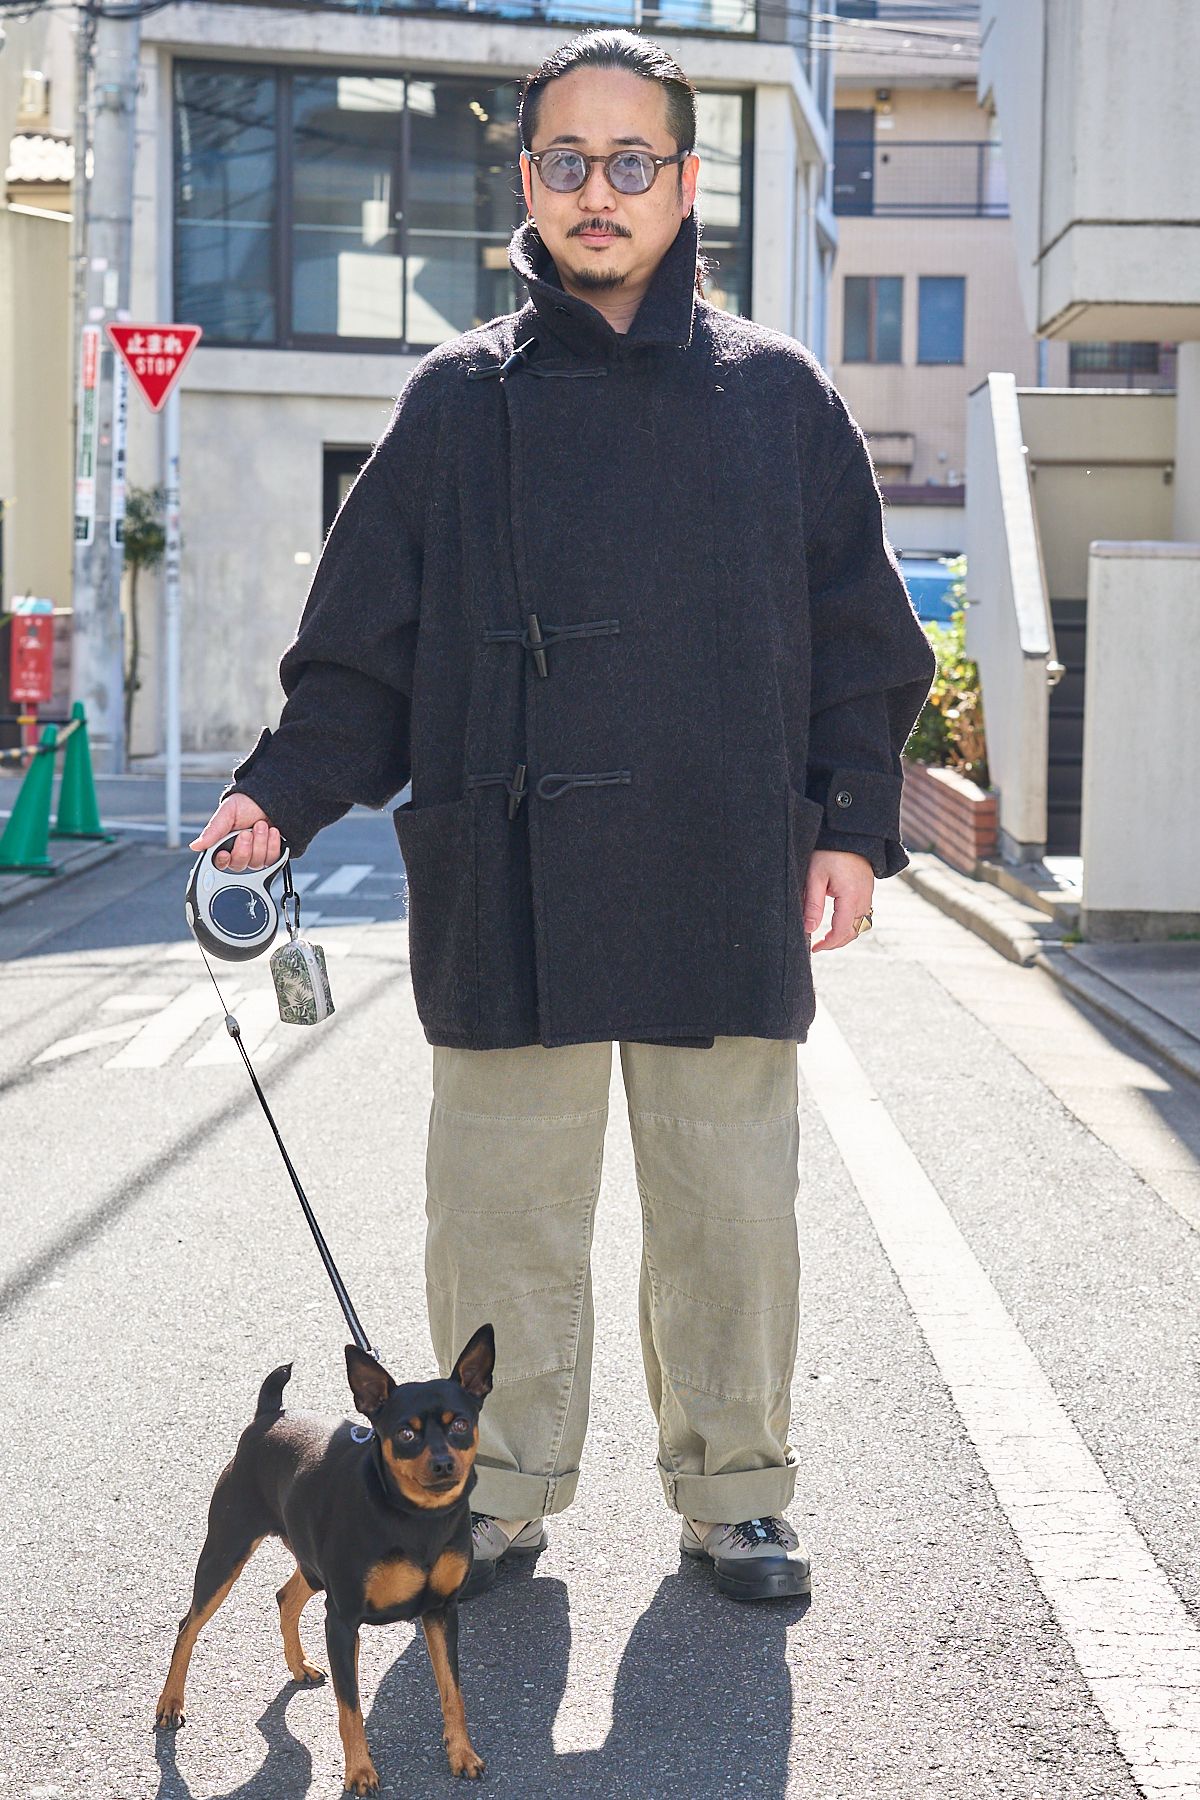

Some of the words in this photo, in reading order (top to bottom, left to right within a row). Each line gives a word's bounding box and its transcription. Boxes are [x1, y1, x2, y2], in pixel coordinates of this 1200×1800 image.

[126, 332, 183, 354] 止まれ
[135, 356, 176, 375] STOP
